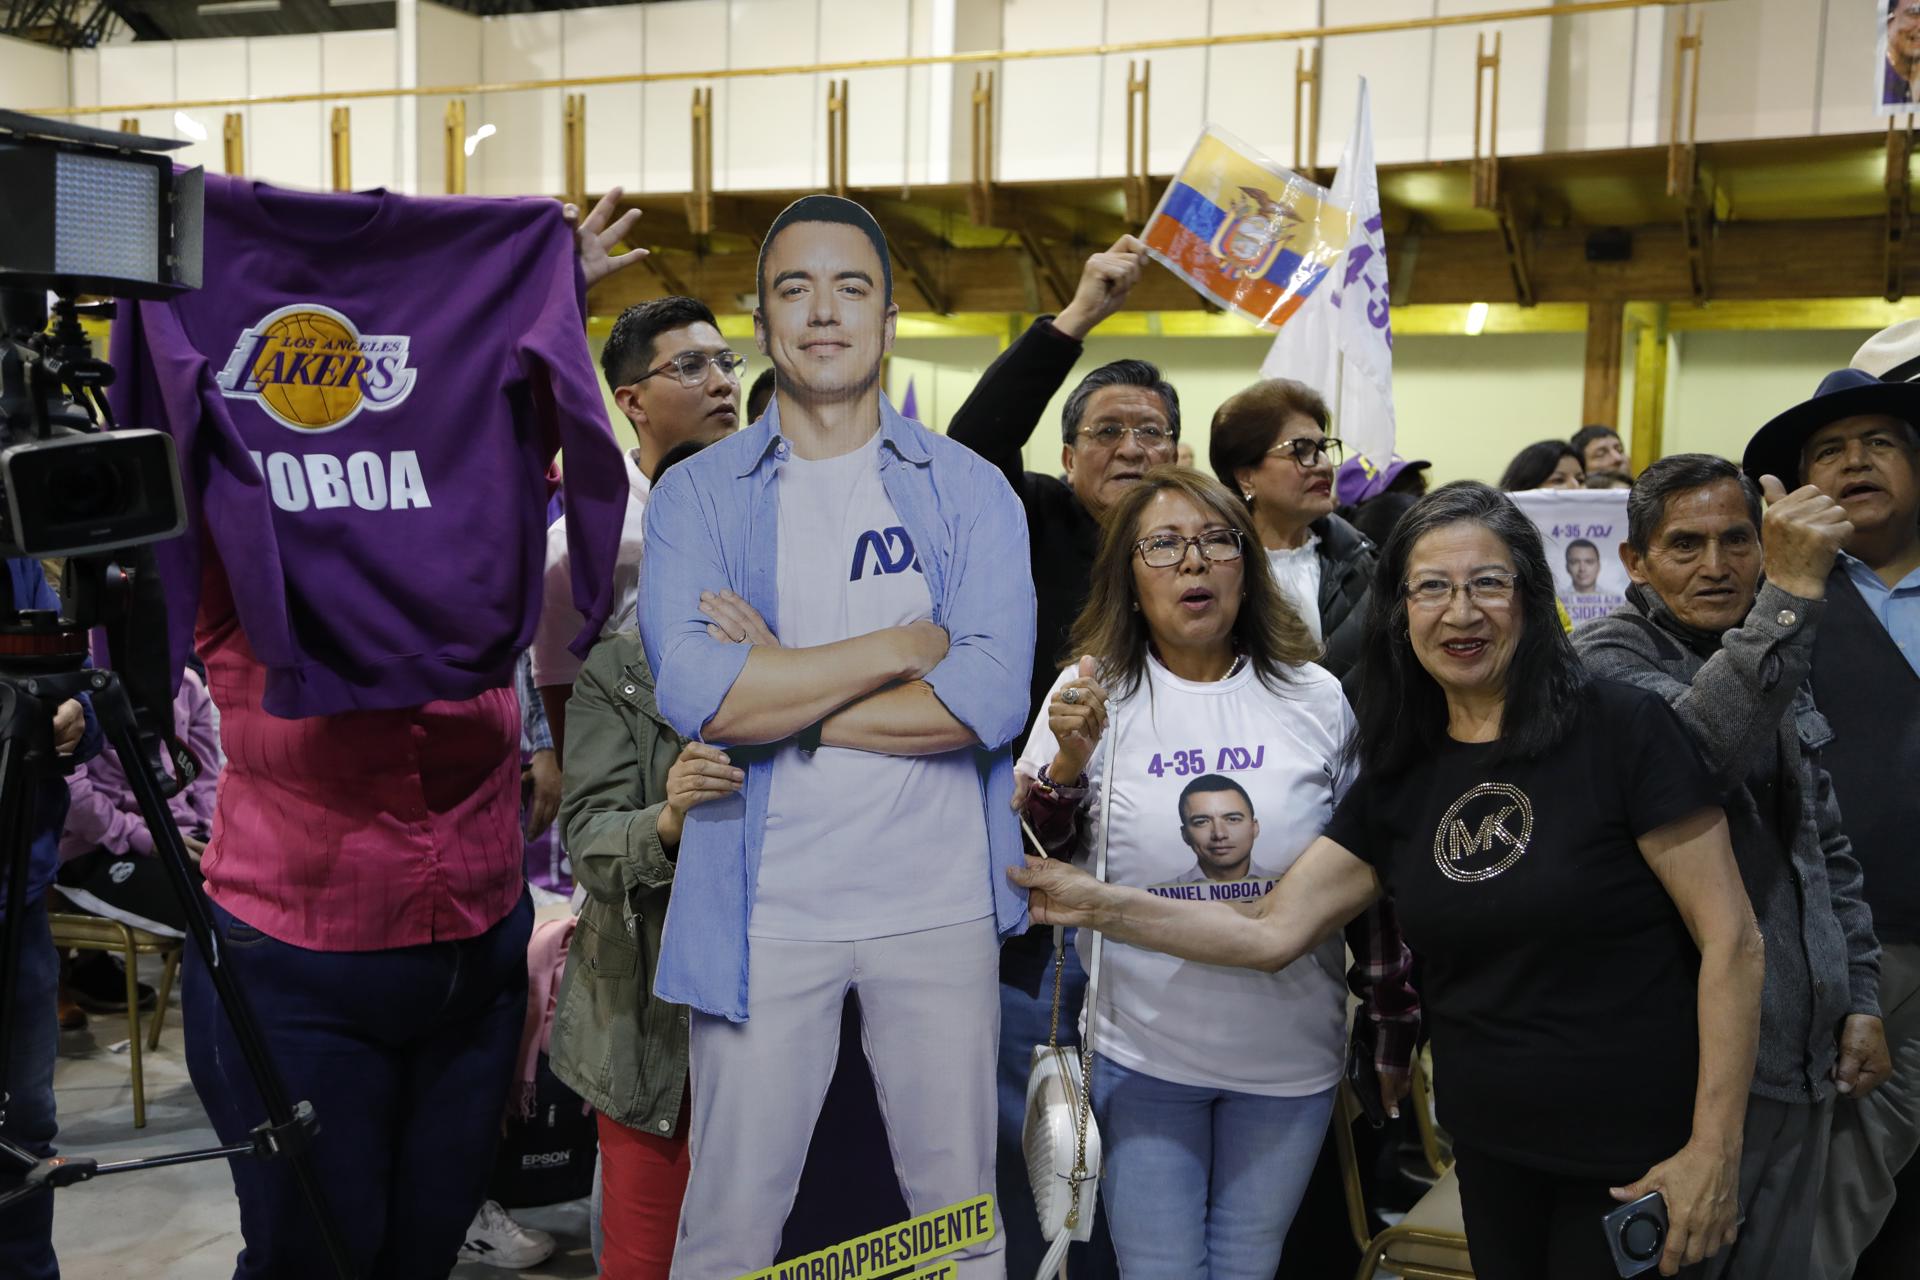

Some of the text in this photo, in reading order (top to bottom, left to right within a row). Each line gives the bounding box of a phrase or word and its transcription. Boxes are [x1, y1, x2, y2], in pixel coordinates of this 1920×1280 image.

[281, 336, 403, 352] LOS ANGELES
[222, 335, 408, 402] LAKERS
[249, 450, 432, 512] OBOA
[1552, 524, 1580, 538] 4-35
[849, 526, 923, 582] AD
[1148, 745, 1265, 778] 4-35 ADJ
[1449, 804, 1520, 860] MK
[1210, 880, 1261, 900] NOBOA
[522, 1150, 570, 1165] EPSON
